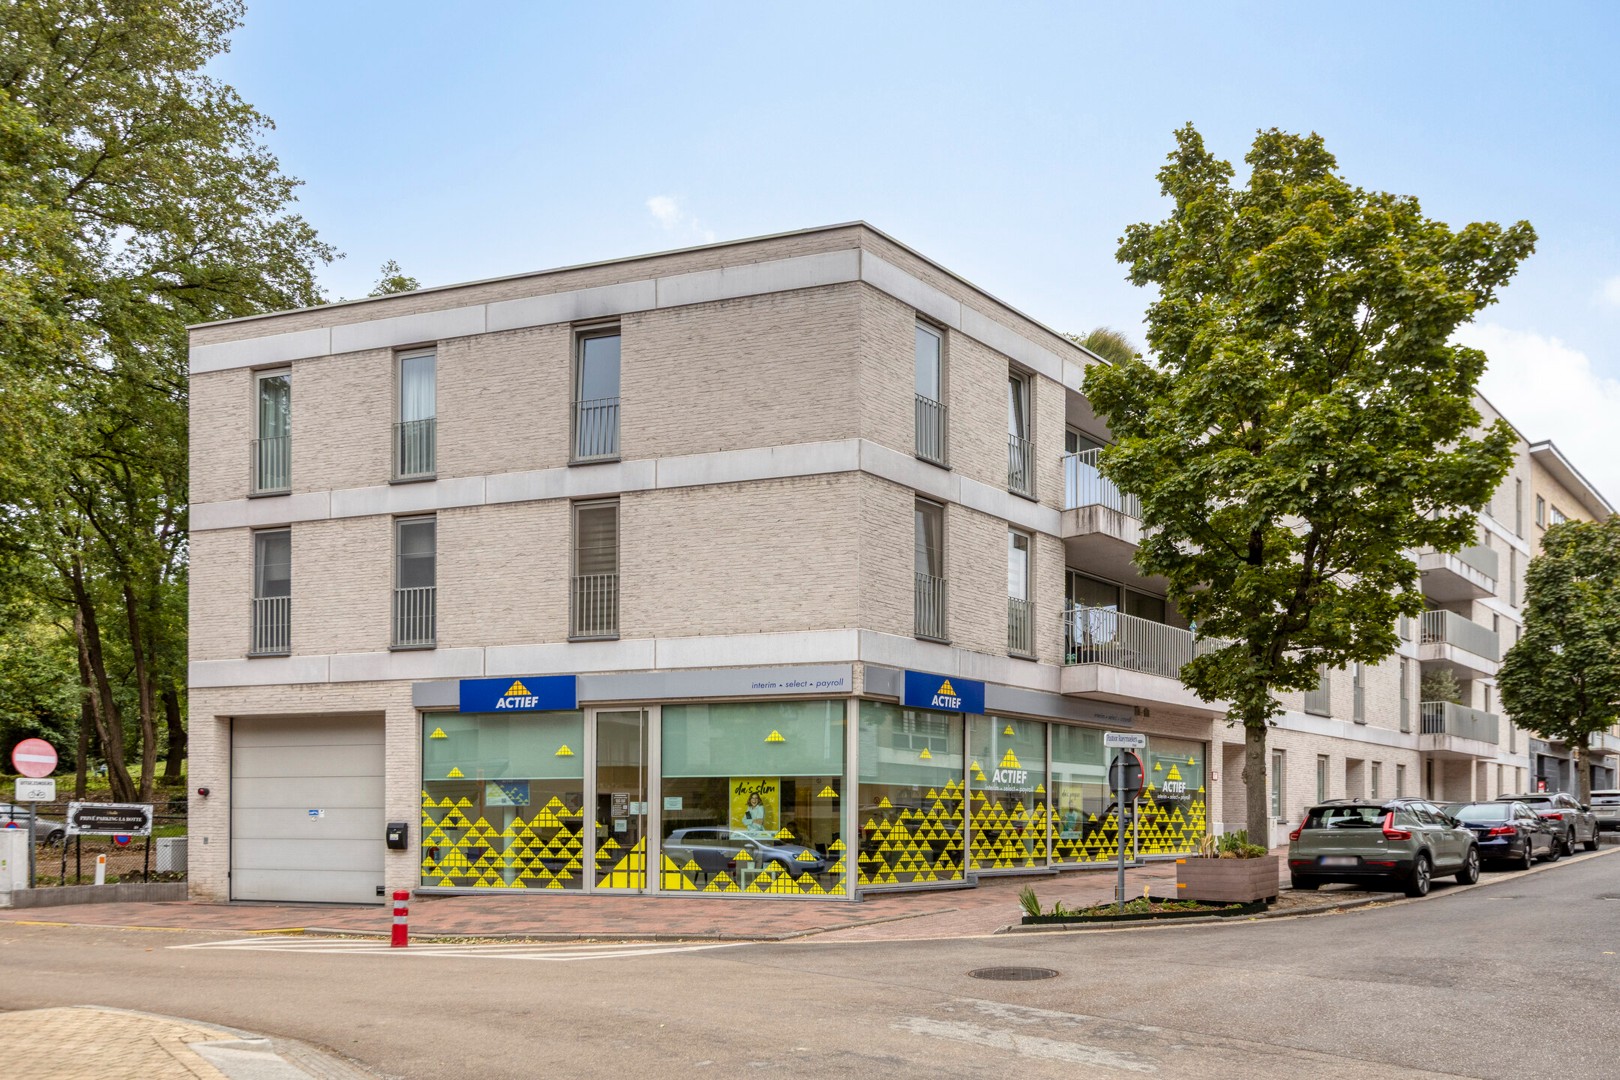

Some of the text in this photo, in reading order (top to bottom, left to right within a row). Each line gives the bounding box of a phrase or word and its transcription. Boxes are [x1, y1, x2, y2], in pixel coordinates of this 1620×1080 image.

[751, 678, 844, 689] interim select payroll
[495, 696, 539, 709] ACTIEF
[931, 694, 962, 709] ACTIEF
[992, 769, 1028, 784] ACTIEF
[755, 779, 776, 795] slim
[1162, 781, 1186, 793] ACTIEF
